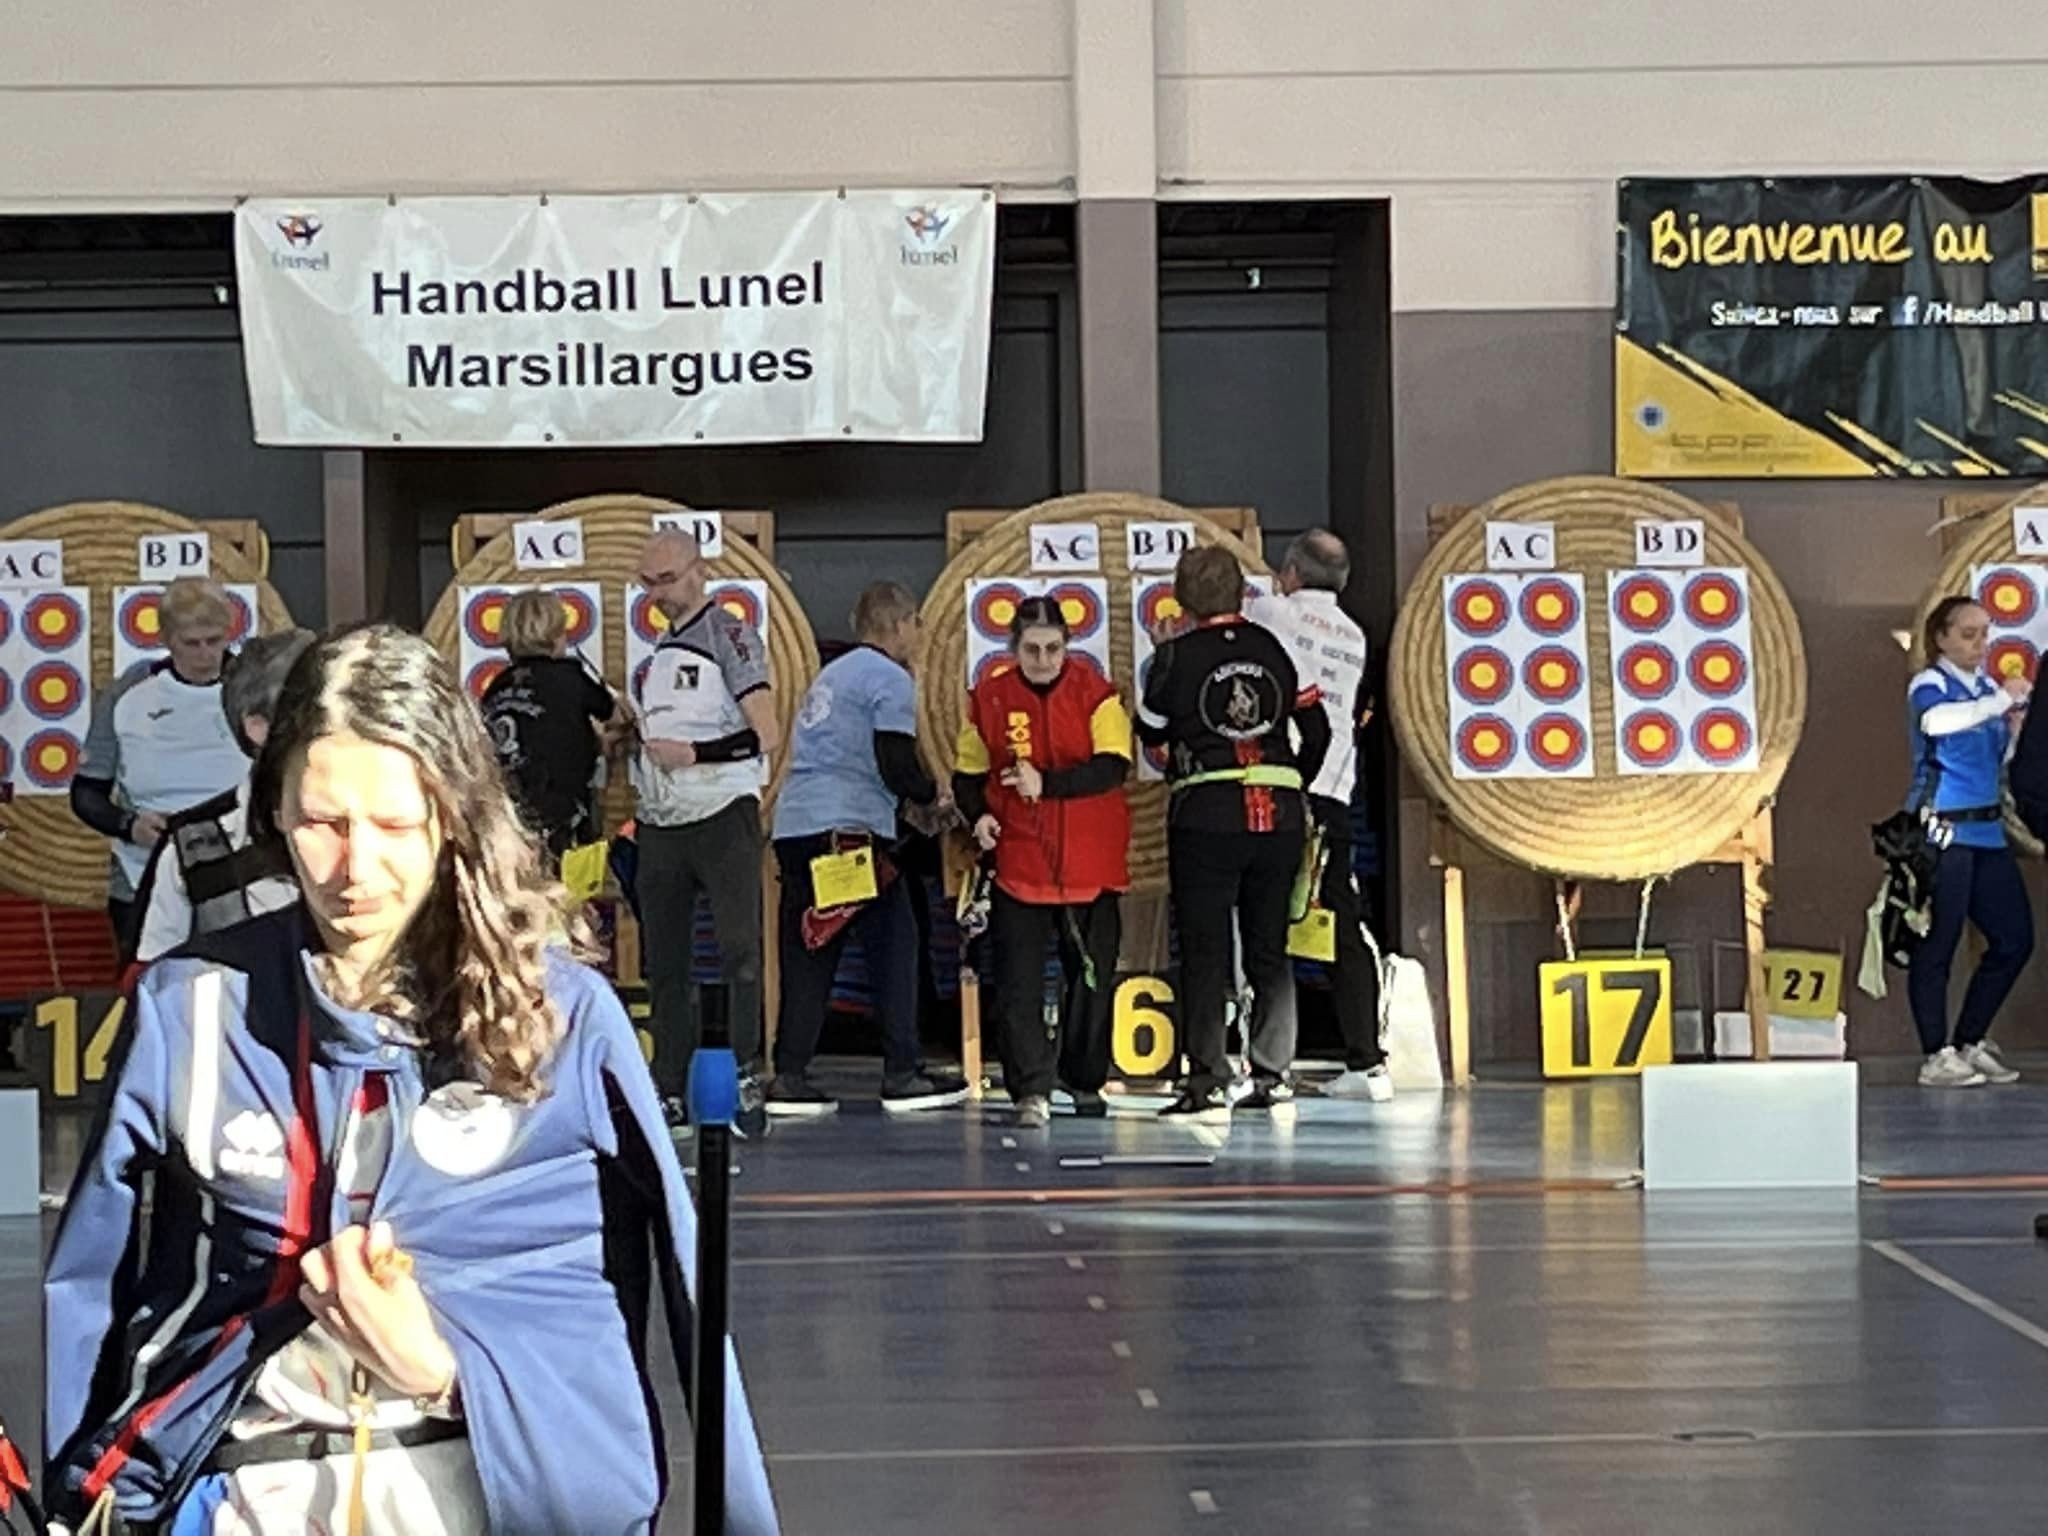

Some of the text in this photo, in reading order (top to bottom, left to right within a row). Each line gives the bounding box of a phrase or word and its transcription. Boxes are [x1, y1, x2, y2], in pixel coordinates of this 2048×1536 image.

[1650, 208, 1995, 269] Bienvenue au
[372, 261, 825, 316] Handball Lunel
[1848, 304, 1884, 326] sur
[406, 341, 814, 395] Marsillargues
[1782, 967, 1826, 1003] 27
[1552, 969, 1663, 1067] 17
